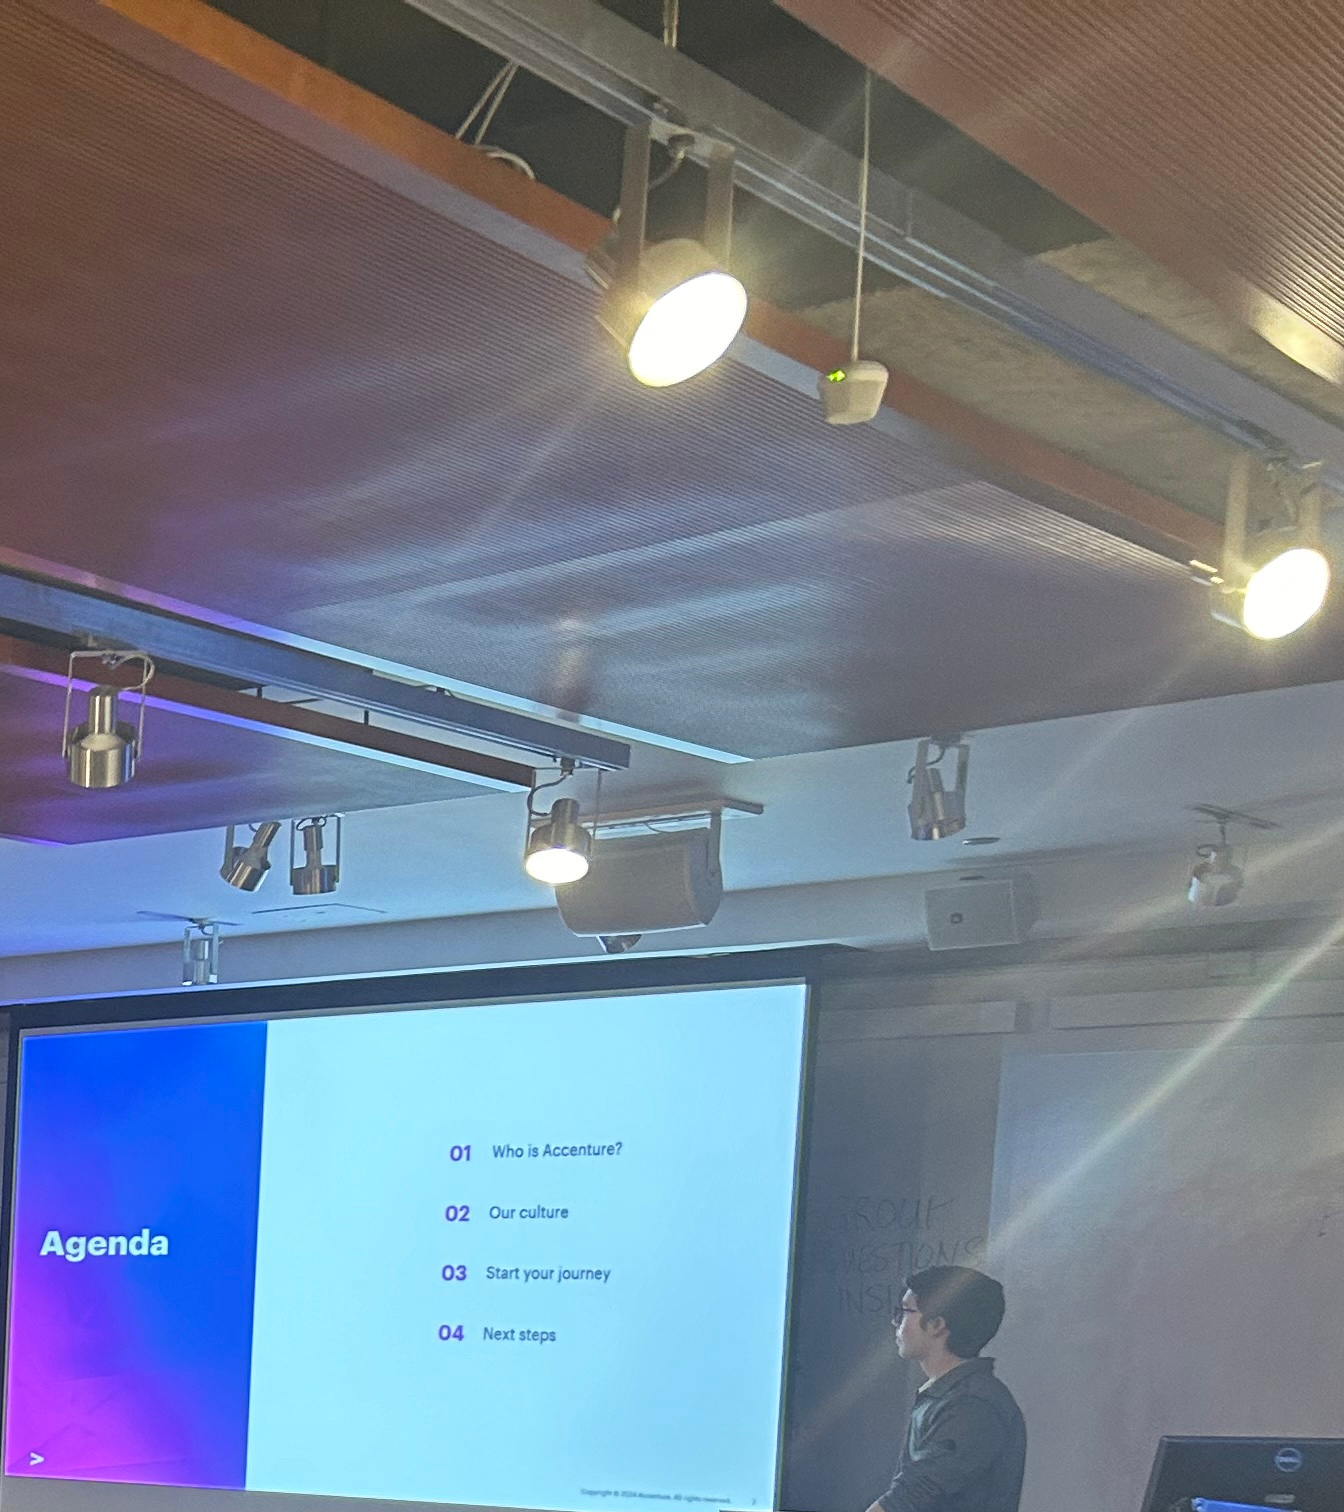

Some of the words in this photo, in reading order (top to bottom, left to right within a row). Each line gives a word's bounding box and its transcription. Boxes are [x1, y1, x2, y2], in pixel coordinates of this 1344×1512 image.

[449, 1144, 472, 1162] 01
[492, 1144, 524, 1159] Who
[527, 1144, 539, 1158] is
[542, 1141, 623, 1157] Accenture?
[445, 1204, 470, 1222] 02
[489, 1205, 516, 1219] Our
[519, 1205, 569, 1219] culture
[40, 1229, 169, 1263] Agenda
[441, 1264, 467, 1282] 03
[486, 1265, 520, 1280] Start
[523, 1269, 555, 1284] your
[557, 1265, 611, 1284] journey
[438, 1324, 465, 1342] 04
[483, 1326, 516, 1341] Next
[518, 1329, 557, 1345] steps
